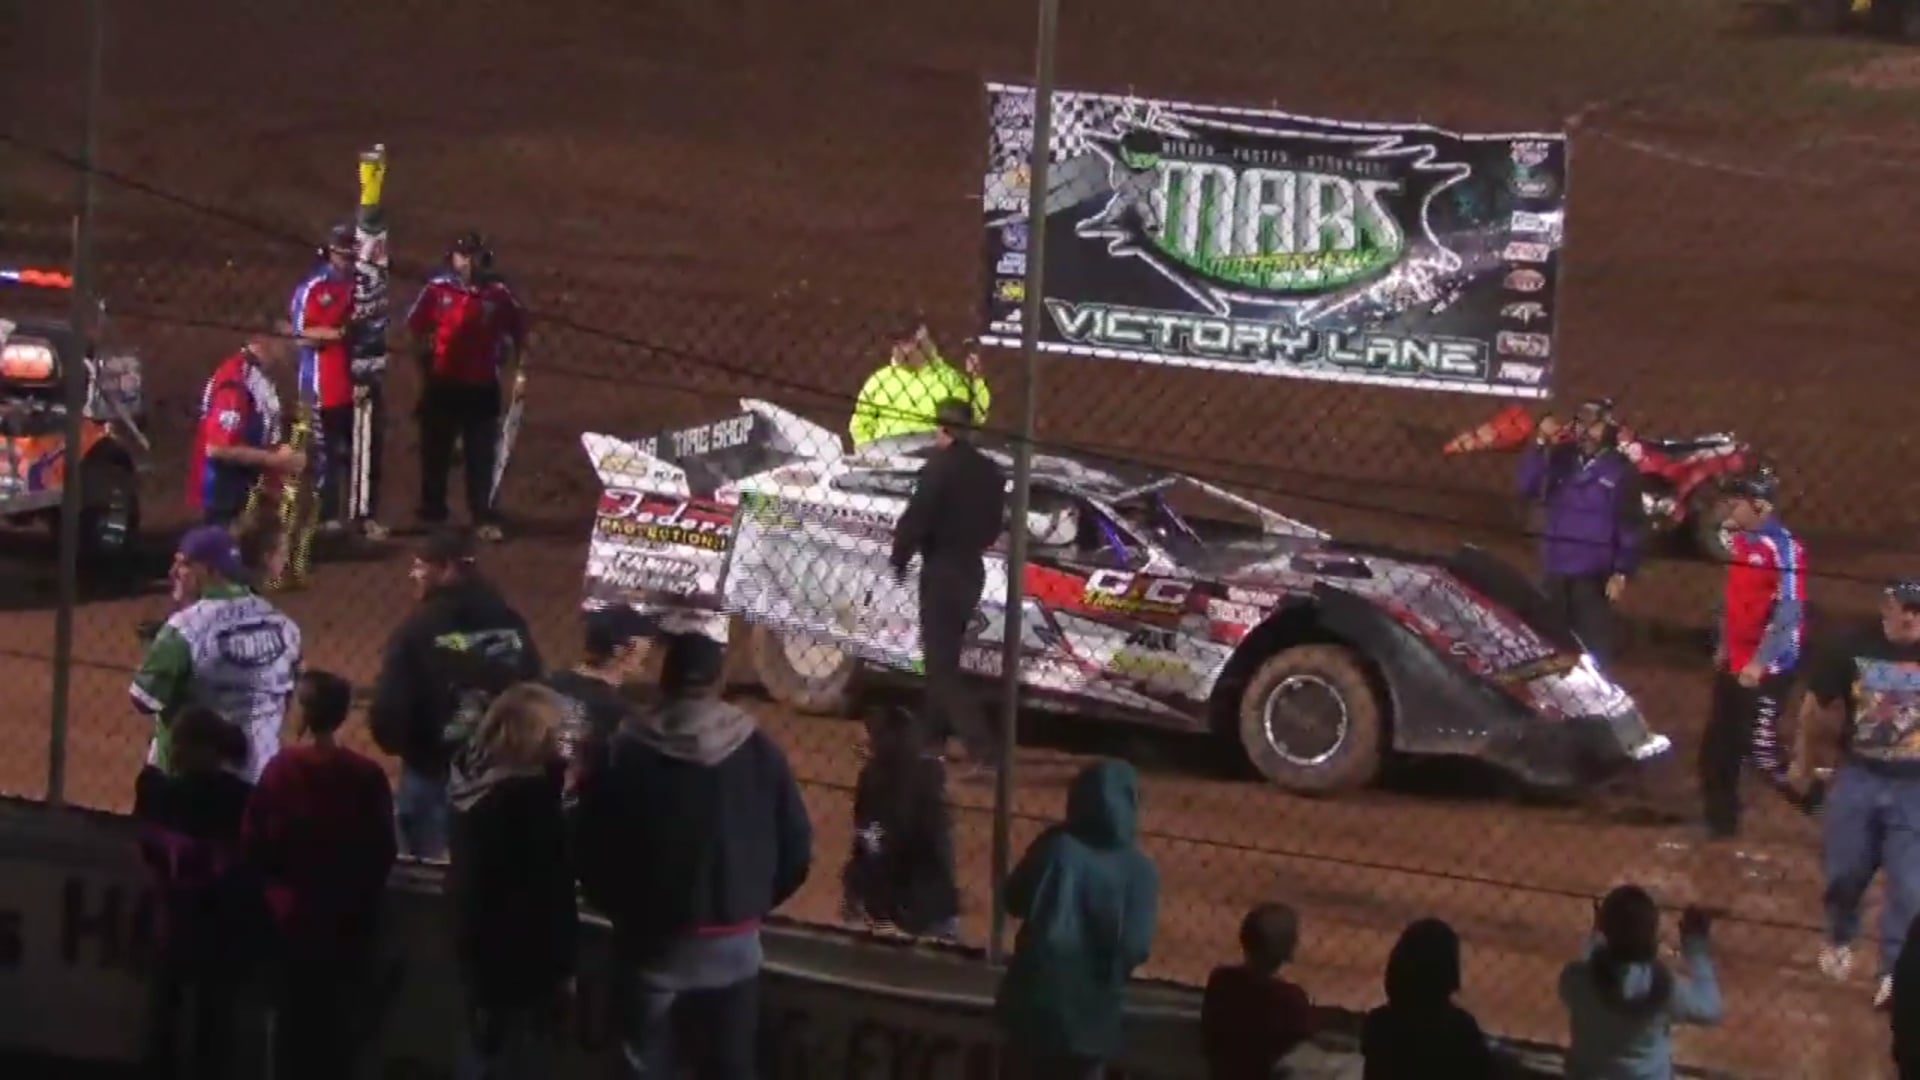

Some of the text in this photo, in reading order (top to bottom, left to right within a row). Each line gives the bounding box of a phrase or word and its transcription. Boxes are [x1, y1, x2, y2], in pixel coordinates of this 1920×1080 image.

[1156, 160, 1403, 256] MARS
[1048, 300, 1311, 353] VICTORY
[1329, 321, 1481, 370] LANE
[673, 424, 710, 456] TIRE
[712, 414, 754, 447] SHOP
